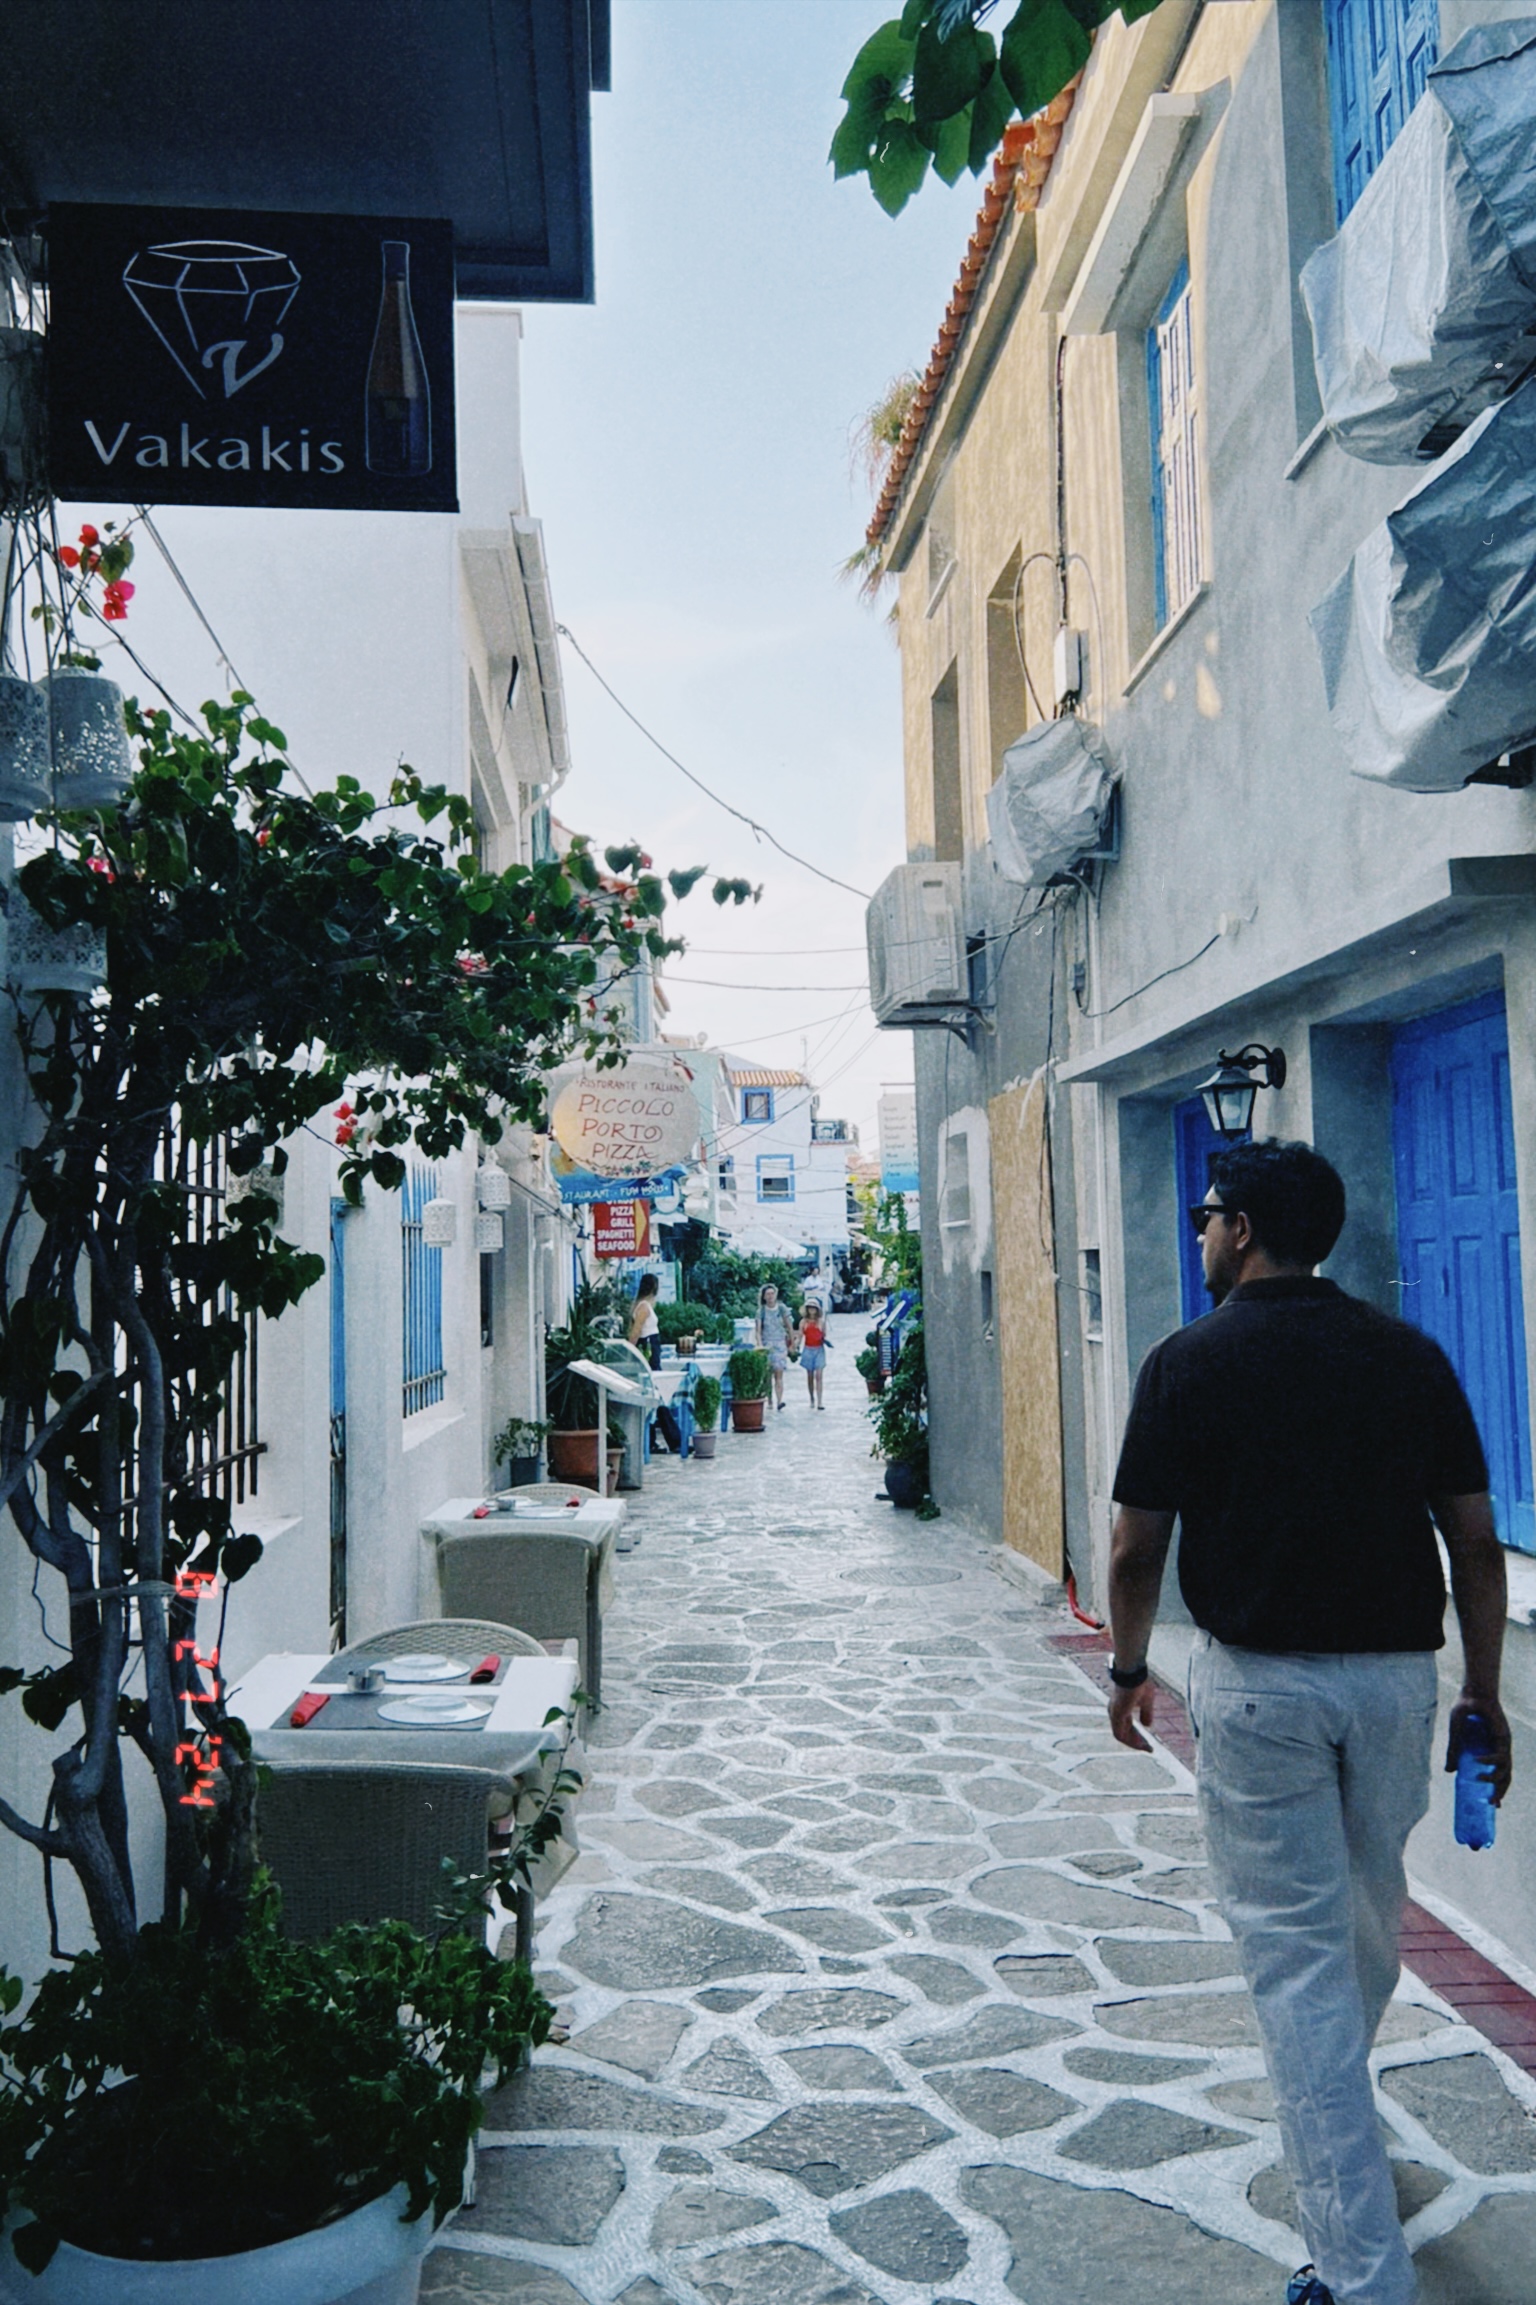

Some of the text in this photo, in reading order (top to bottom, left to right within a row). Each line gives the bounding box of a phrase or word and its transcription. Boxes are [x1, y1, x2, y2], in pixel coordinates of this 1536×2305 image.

[83, 419, 346, 475] Vakakis
[579, 1077, 638, 1090] RISTORANTE
[578, 1093, 674, 1116] PICCOLO
[581, 1118, 663, 1143] PORTO
[592, 1142, 658, 1160] PIZZA
[564, 1189, 610, 1200] STAURANT
[610, 1206, 635, 1216] PIZZA
[610, 1217, 635, 1227] GRILL
[597, 1229, 635, 1239] SPAGHETTI
[597, 1241, 636, 1251] SEAFOOD
